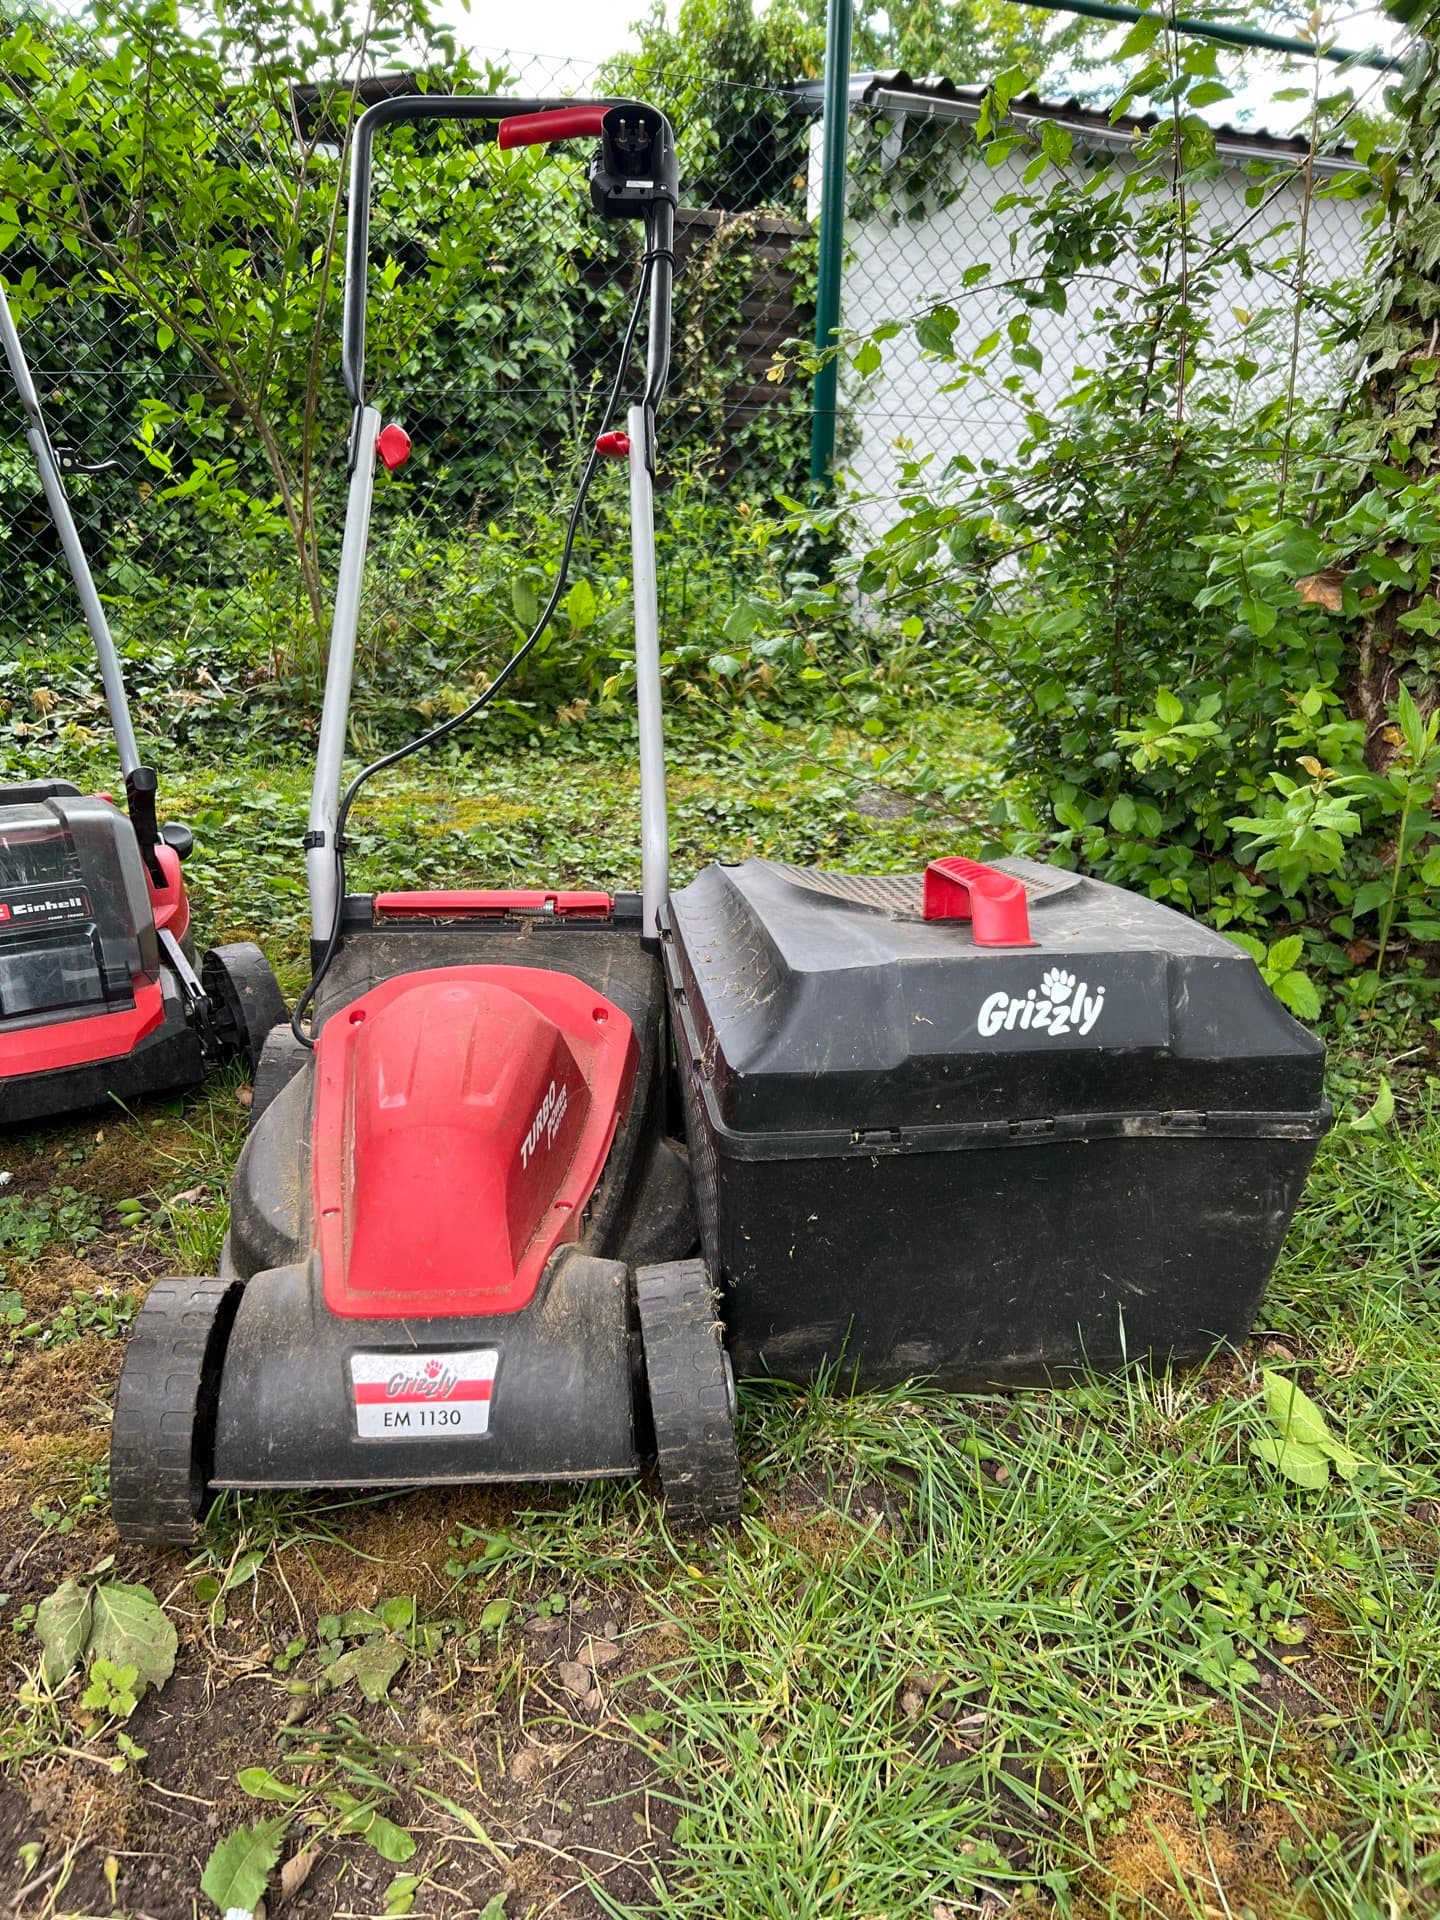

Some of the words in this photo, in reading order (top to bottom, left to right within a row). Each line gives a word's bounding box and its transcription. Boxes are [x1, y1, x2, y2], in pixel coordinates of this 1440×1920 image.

[12, 897, 82, 915] Einhell
[977, 982, 1105, 1037] Grizzly
[520, 1080, 556, 1170] TURBO
[547, 1083, 567, 1150] POWER
[385, 1367, 458, 1399] Grizzly
[384, 1411, 411, 1427] EM
[419, 1409, 462, 1427] 1130
